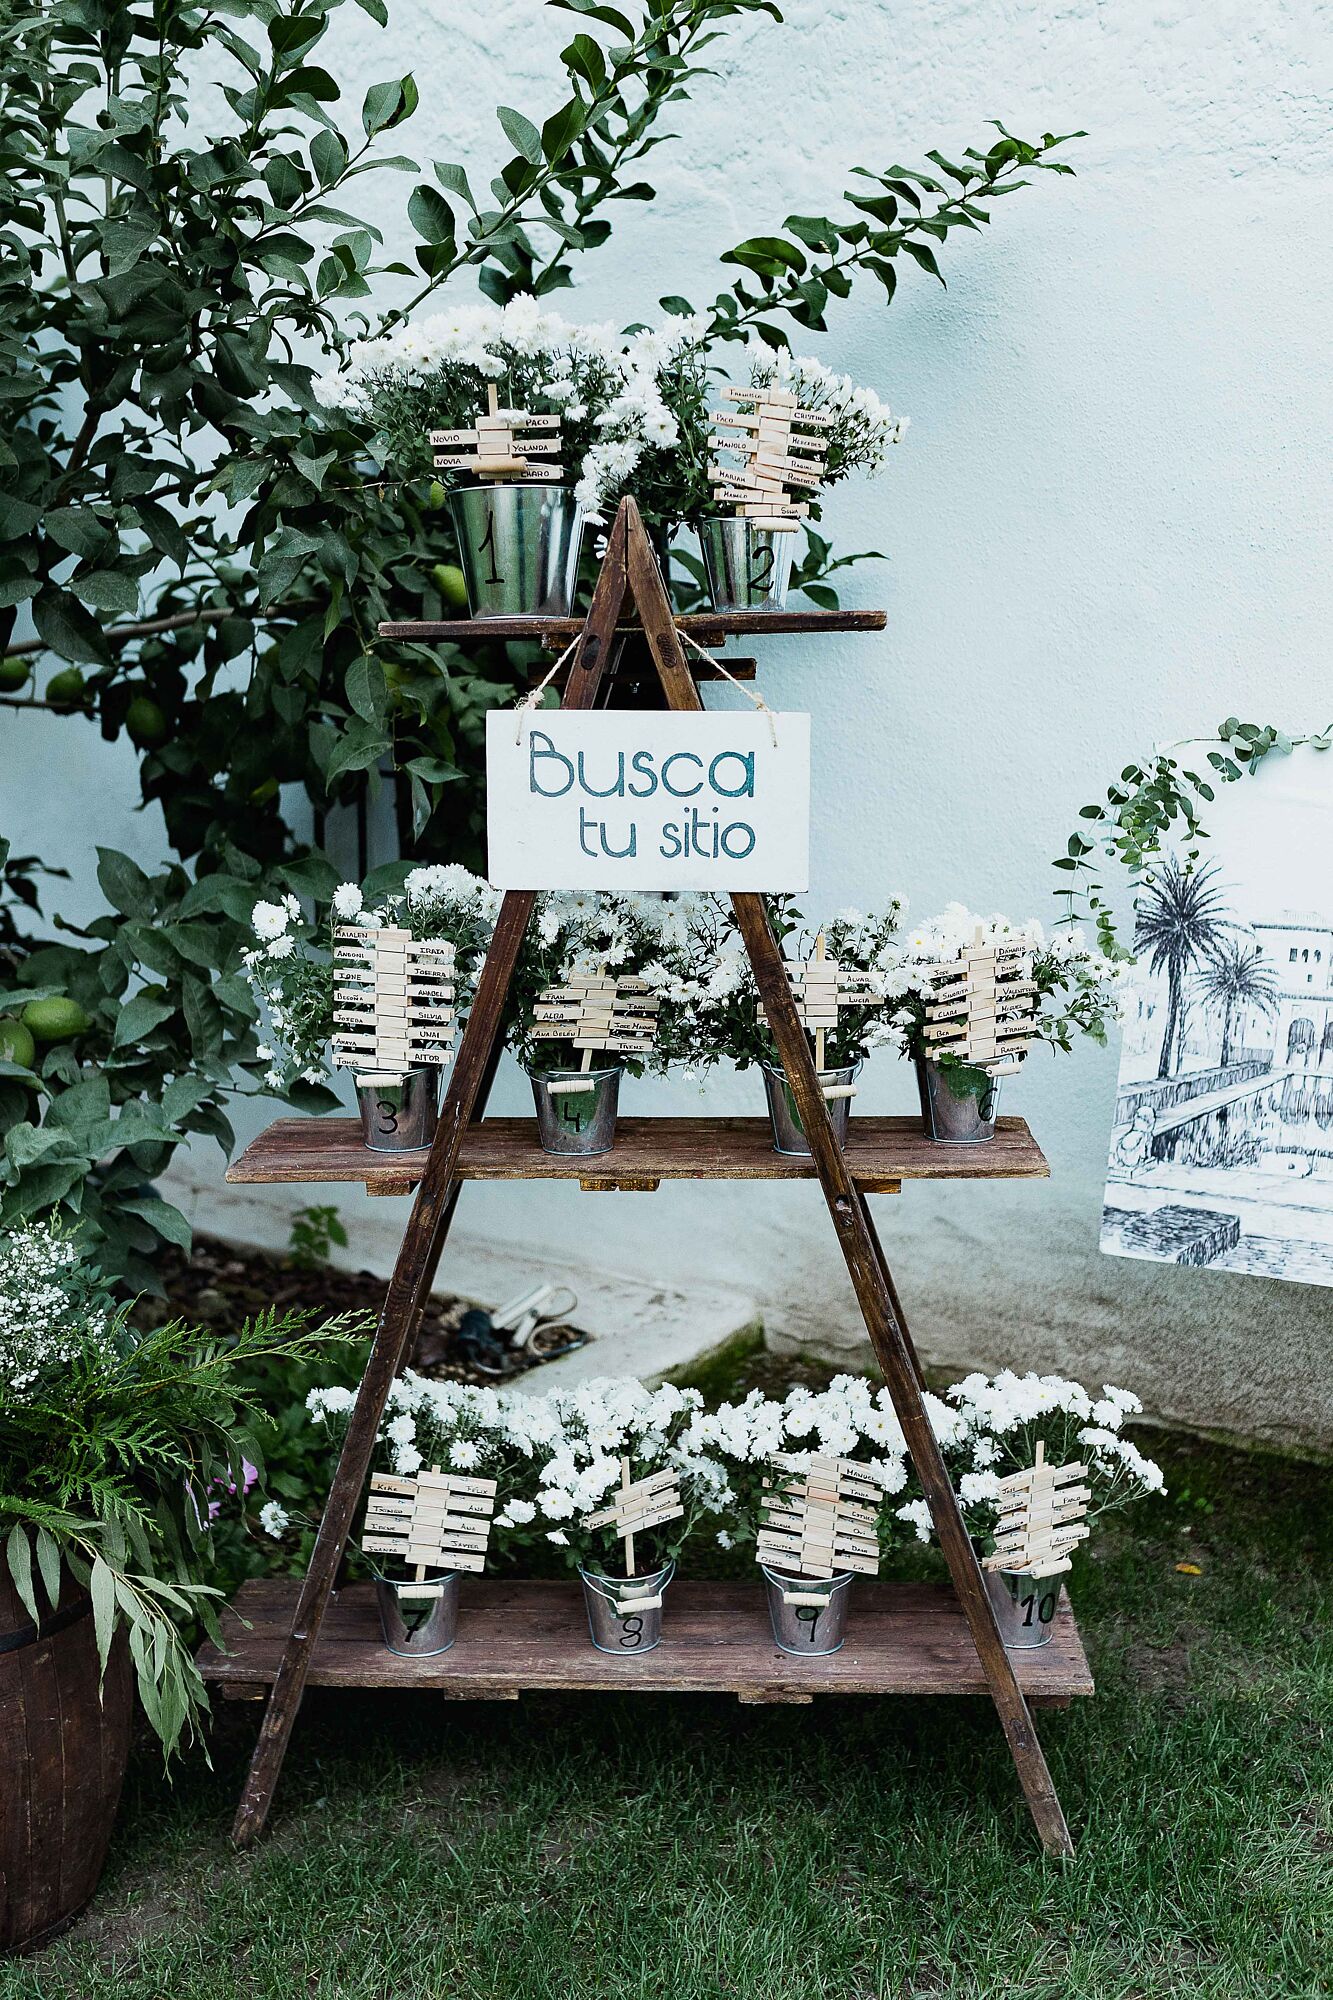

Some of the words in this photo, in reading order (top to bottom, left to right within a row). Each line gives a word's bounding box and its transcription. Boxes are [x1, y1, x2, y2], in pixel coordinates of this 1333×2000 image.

[716, 413, 734, 423] PACO
[794, 412, 827, 423] CRISTINA
[526, 419, 549, 427] PACO
[433, 435, 460, 443] NOVIO
[717, 439, 747, 449] MANOLO
[512, 444, 549, 452] YOLANDA
[478, 510, 505, 585] 1
[747, 545, 775, 592] 2
[530, 730, 755, 798] Busca
[579, 807, 637, 858] tu
[659, 806, 756, 859] sitio
[335, 928, 368, 939] MAIALEN
[420, 947, 445, 955] IRAIA
[339, 973, 362, 981] IONE
[846, 975, 871, 983] ALVAR
[849, 996, 870, 1004] LUCIA
[418, 1012, 442, 1020] SILVIA
[543, 1012, 564, 1020] ALBA
[938, 1010, 957, 1018] CLARA
[419, 1031, 440, 1039] UNAI
[552, 1029, 576, 1037] BELÉN
[414, 1053, 440, 1062] AITOR
[978, 1087, 998, 1121] 6
[376, 1100, 399, 1135] 3
[563, 1101, 580, 1132] 4
[461, 1523, 476, 1531] ANA
[1021, 1592, 1056, 1627] 10
[402, 1609, 429, 1643] 7
[795, 1605, 819, 1642] 9
[619, 1616, 643, 1647] 8
